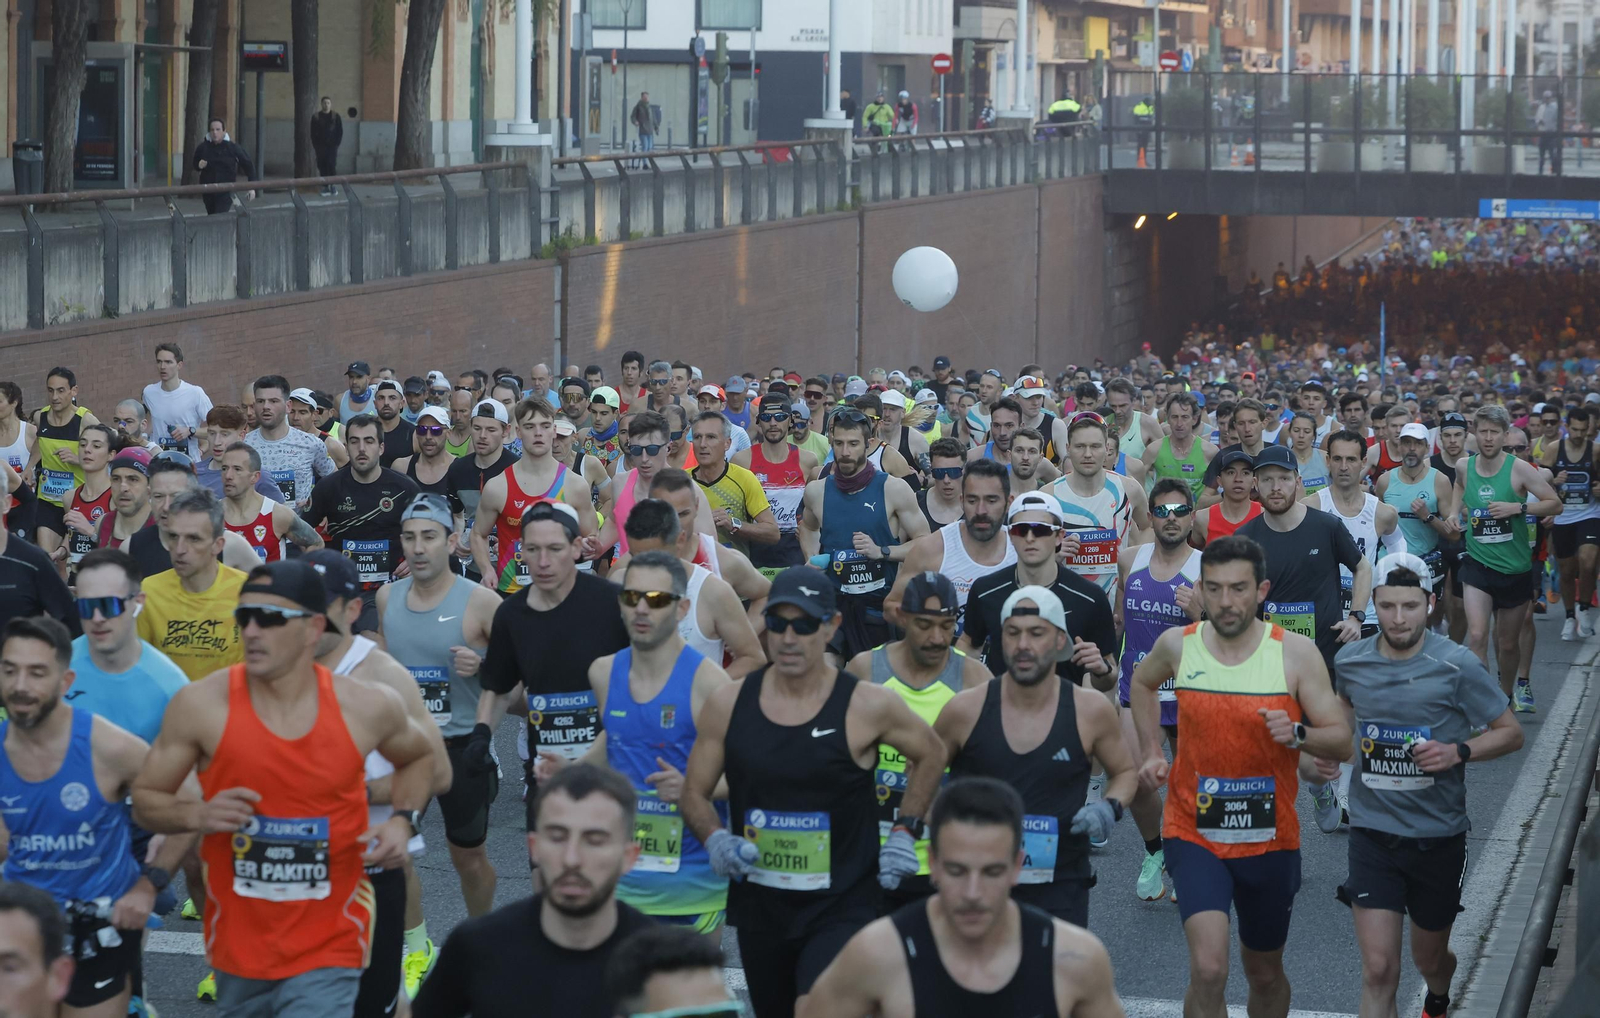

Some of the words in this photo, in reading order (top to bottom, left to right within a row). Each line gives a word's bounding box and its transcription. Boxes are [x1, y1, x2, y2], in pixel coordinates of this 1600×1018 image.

[50, 471, 71, 479] ZURICH
[1083, 533, 1111, 541] ZURICH
[1482, 527, 1502, 535] ALEX
[358, 542, 384, 550] ZURICH
[1072, 554, 1111, 565] MORTEN
[848, 572, 873, 584] JOAN
[1126, 598, 1139, 610] EL
[1279, 605, 1308, 613] ZURICH
[167, 619, 224, 637] BREST
[549, 695, 589, 707] ZURICH
[539, 726, 596, 744] PHILIPPE
[1384, 748, 1406, 759] 3163
[1223, 780, 1266, 793] ZURICH
[1224, 801, 1248, 812] 3064
[770, 816, 820, 829] ZURICH
[1220, 813, 1252, 829] JAVI
[763, 851, 808, 870] COTRI
[234, 859, 259, 879] ER
[261, 861, 327, 882] PAKITO
